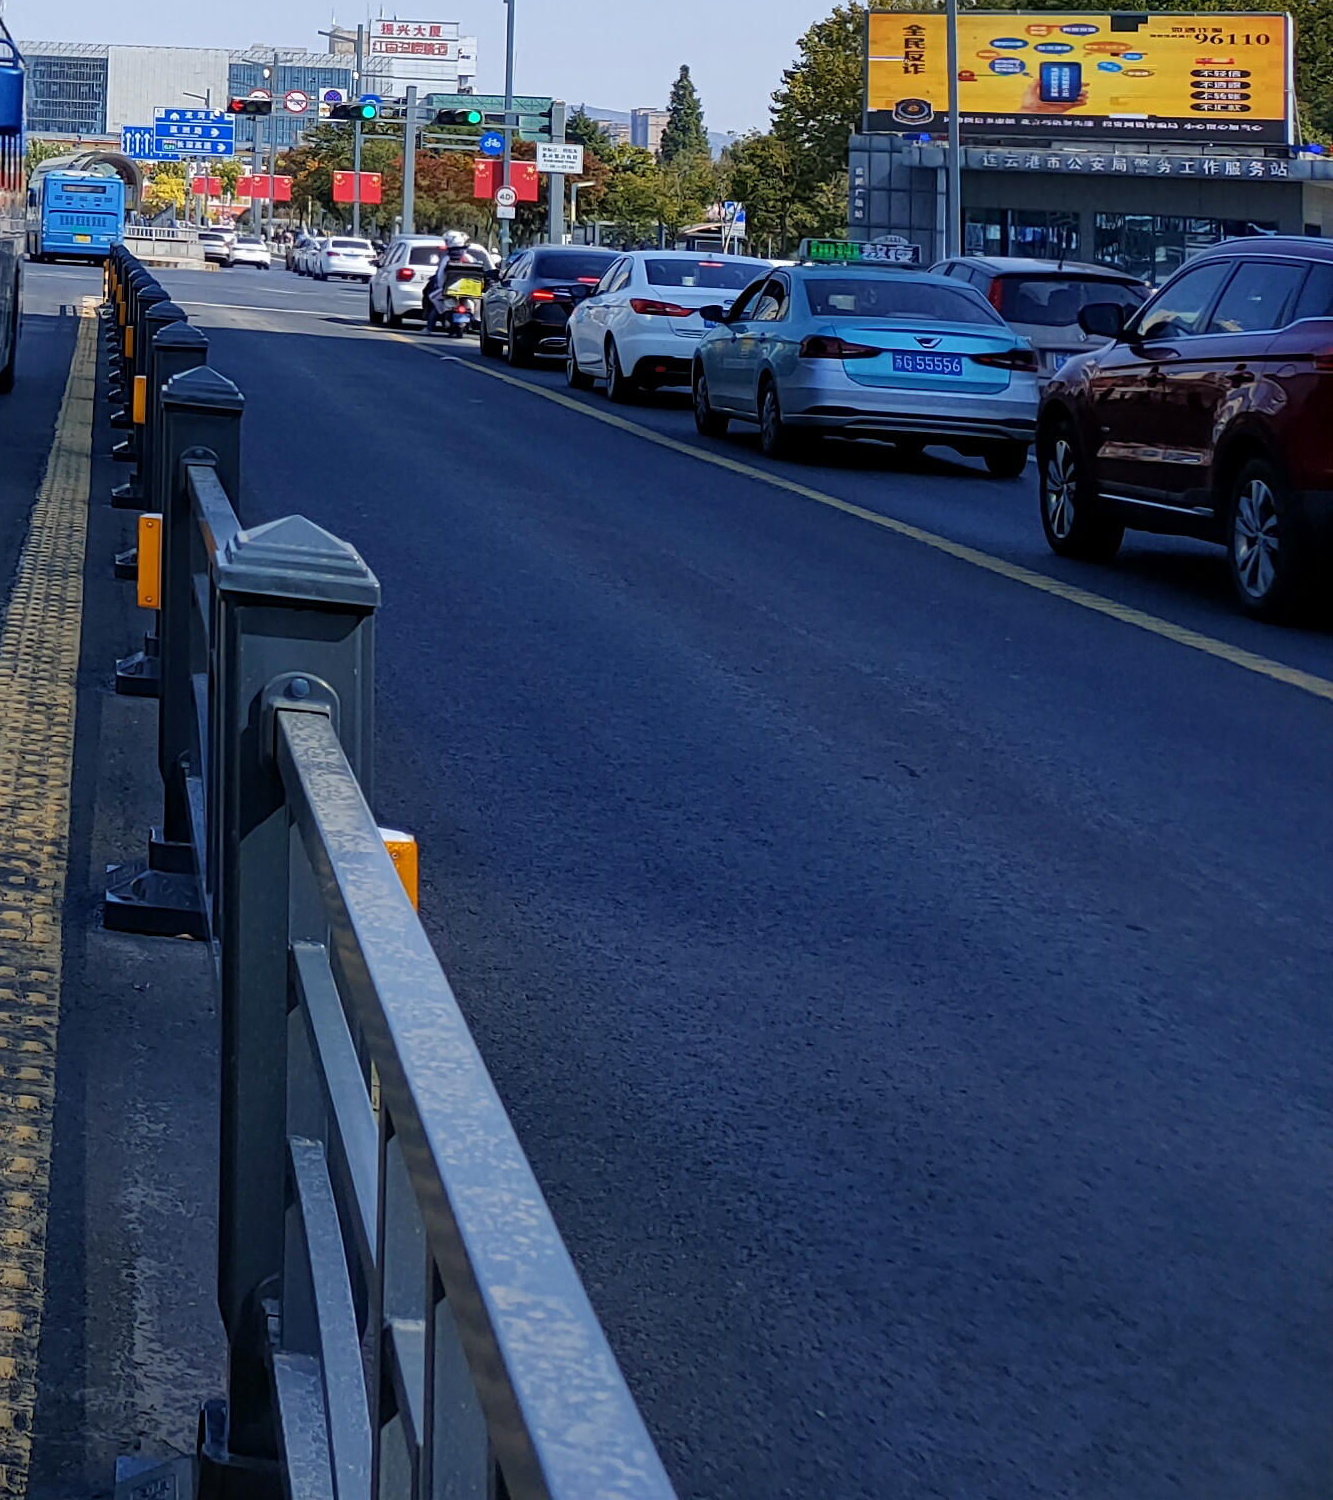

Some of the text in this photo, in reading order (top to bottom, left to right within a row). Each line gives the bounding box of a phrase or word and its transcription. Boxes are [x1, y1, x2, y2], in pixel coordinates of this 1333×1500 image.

[381, 22, 443, 38] 振兴大厦
[1194, 33, 1271, 46] 96110
[903, 24, 926, 75] 全民反诈
[1200, 69, 1242, 79] 不轻信
[1200, 103, 1242, 113] 不汇款
[982, 153, 1289, 178] 连云港市公安局警务工作服务站
